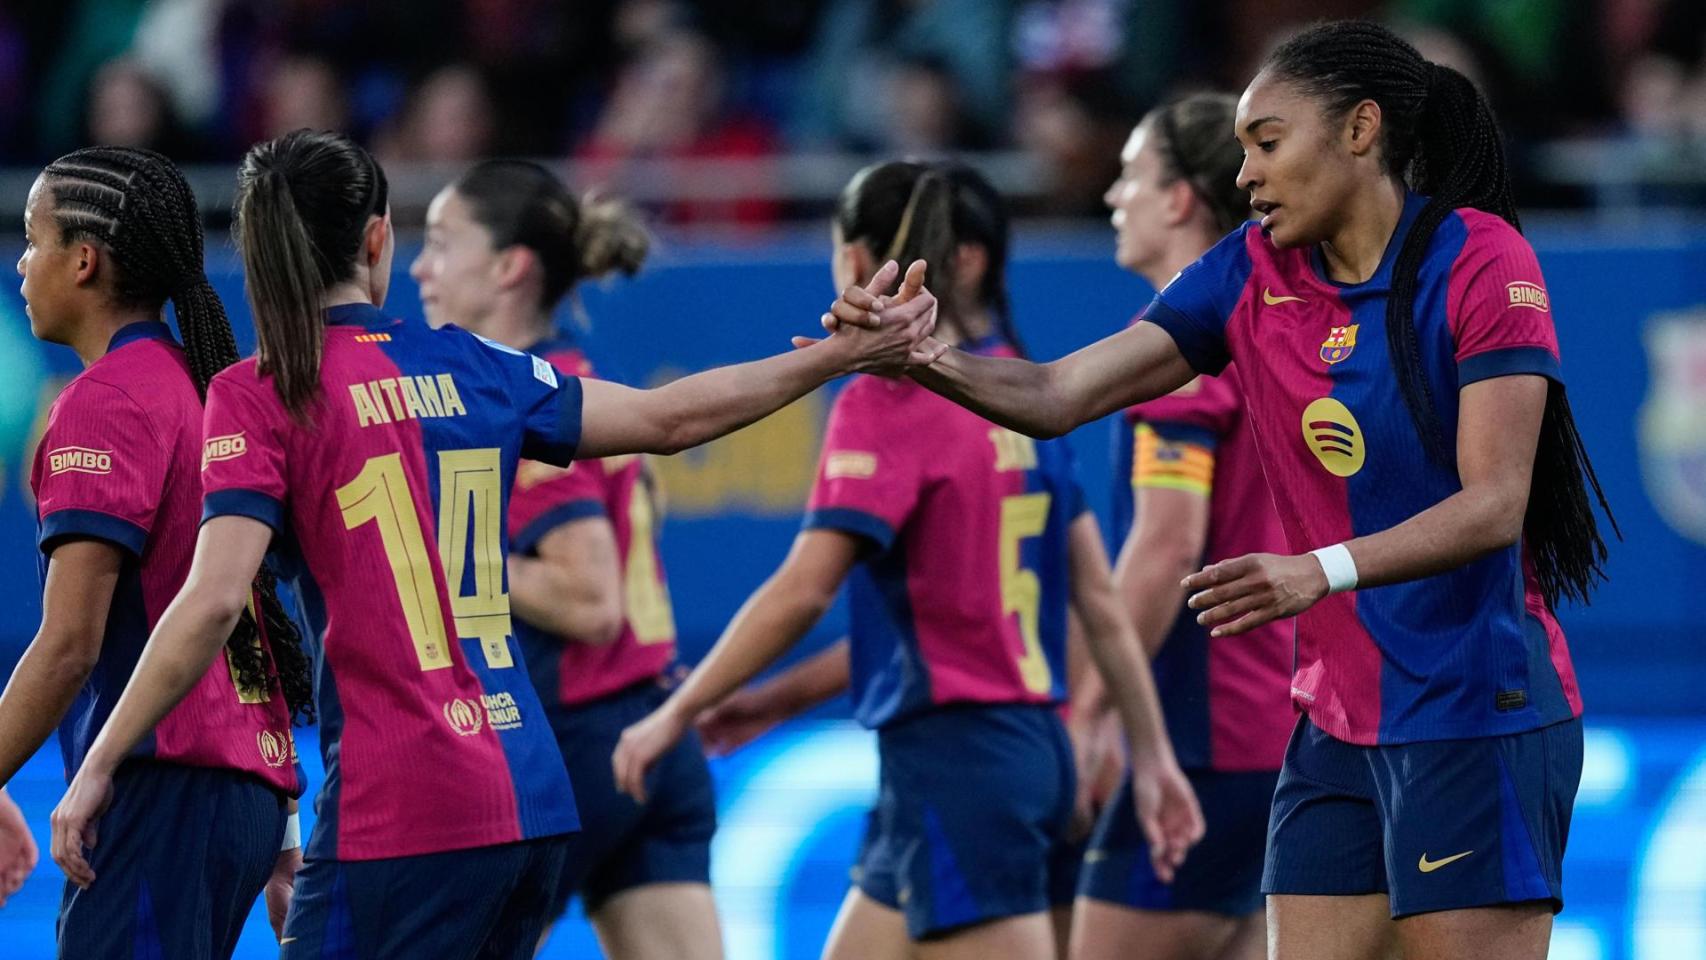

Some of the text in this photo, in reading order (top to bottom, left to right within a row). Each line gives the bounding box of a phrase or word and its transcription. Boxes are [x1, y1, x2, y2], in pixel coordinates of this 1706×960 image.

[1508, 286, 1547, 308] BIMBO
[349, 373, 467, 427] AITANA
[50, 451, 111, 471] BIMBO
[335, 448, 515, 671] 14
[999, 492, 1052, 694] 5
